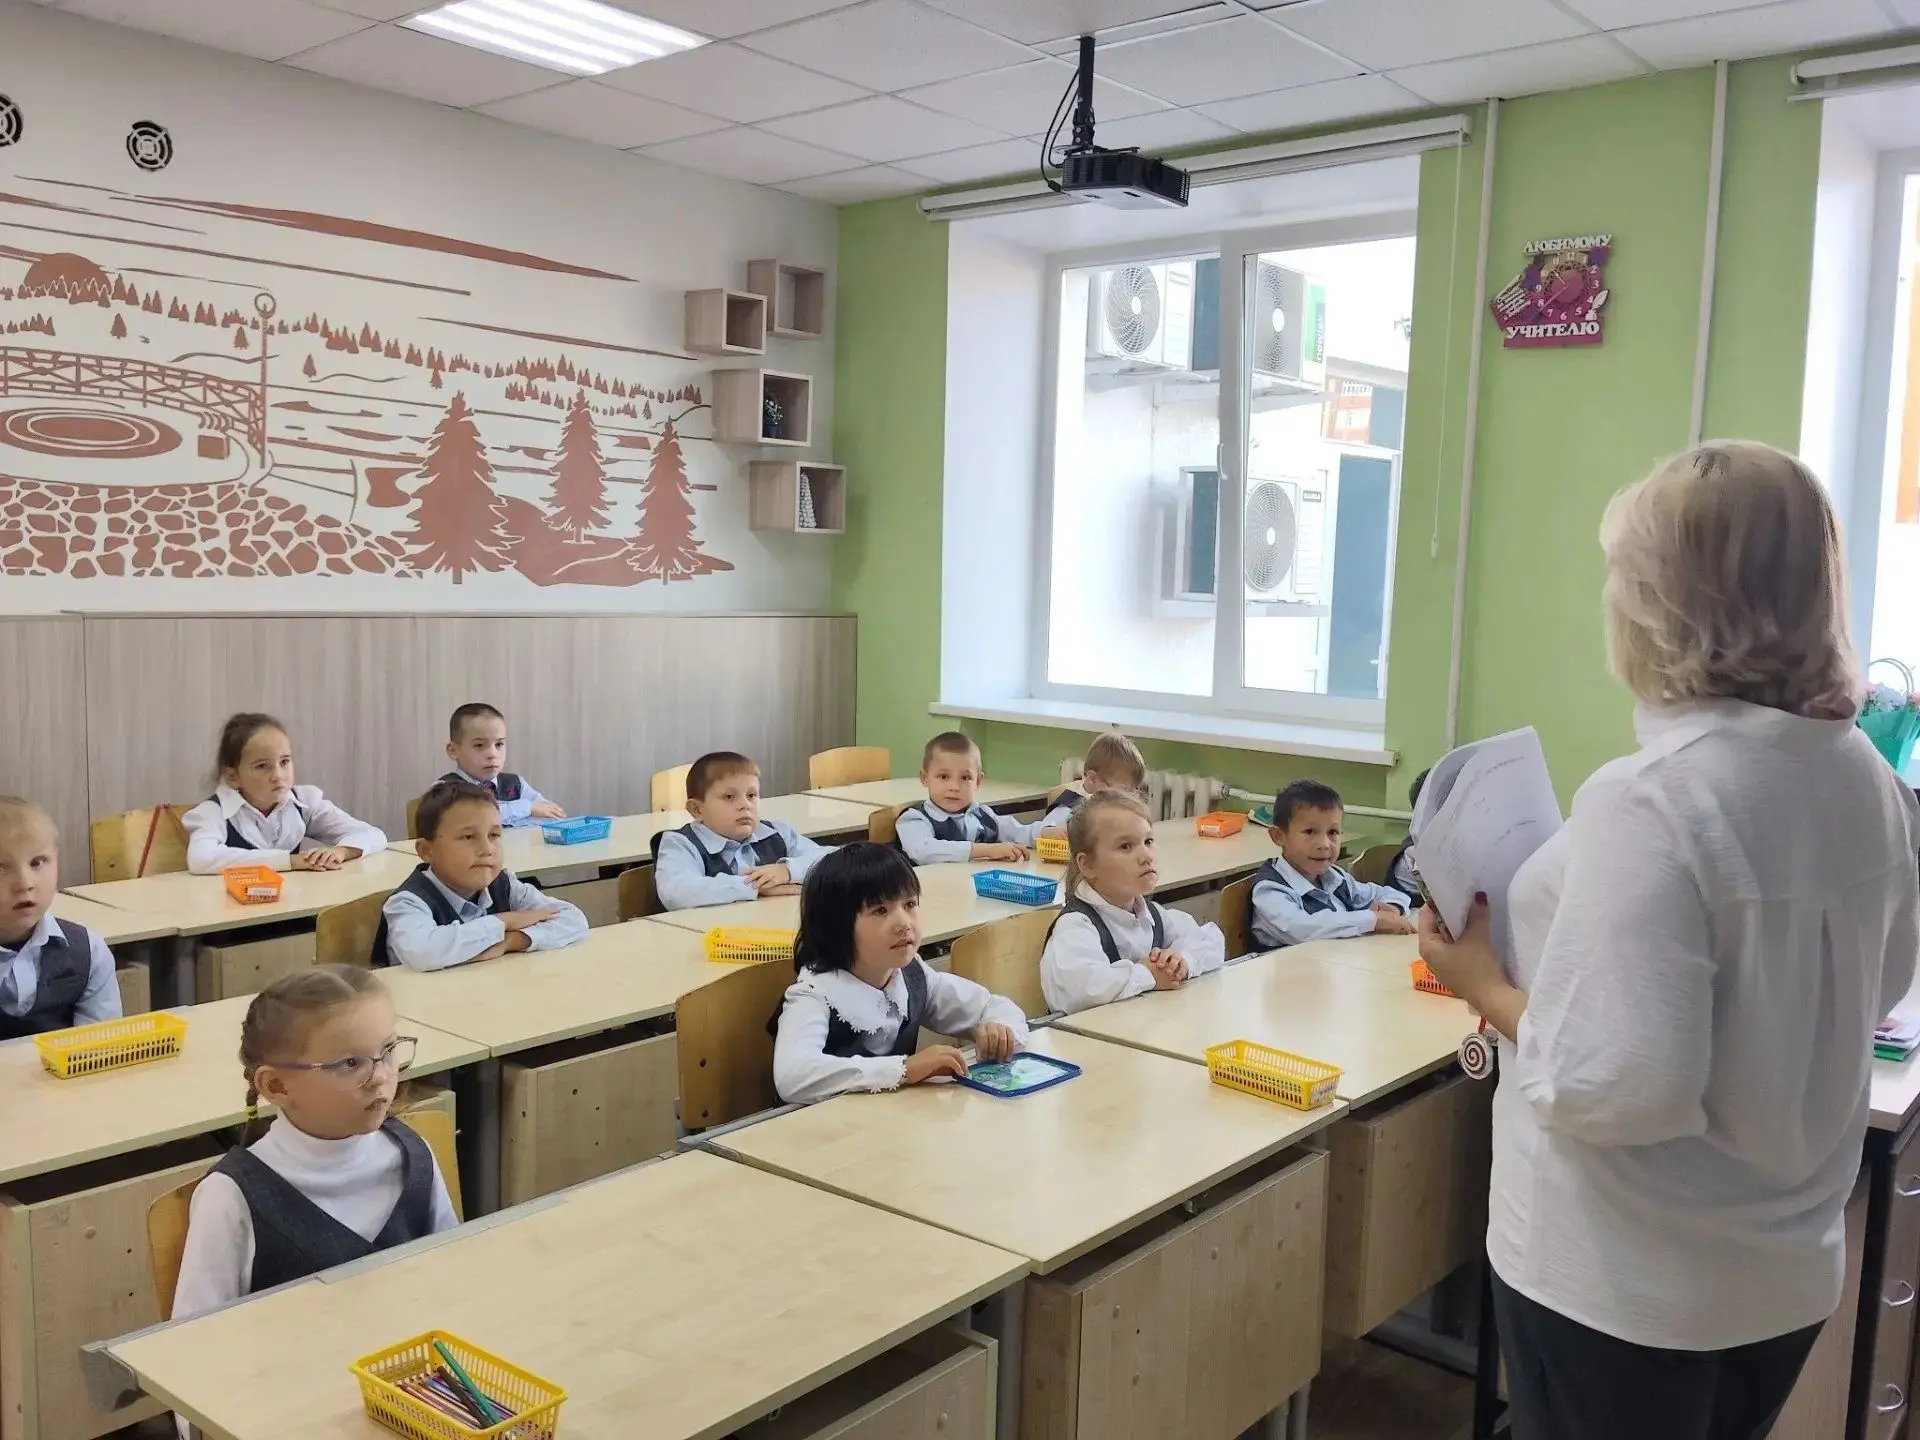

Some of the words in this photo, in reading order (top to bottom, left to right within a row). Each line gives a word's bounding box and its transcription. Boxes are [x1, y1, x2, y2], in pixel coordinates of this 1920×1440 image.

[1524, 235, 1612, 253] ЛЮБИМОМУ
[1590, 265, 1597, 274] 2
[1536, 284, 1542, 292] 9
[1593, 280, 1599, 288] 3
[1538, 299, 1545, 307] 8
[1587, 295, 1593, 303] 4
[1547, 309, 1553, 317] 7
[1575, 307, 1582, 315] 5
[1561, 312, 1567, 320] 6
[1506, 322, 1600, 339] УЧИТЕЛЮ
